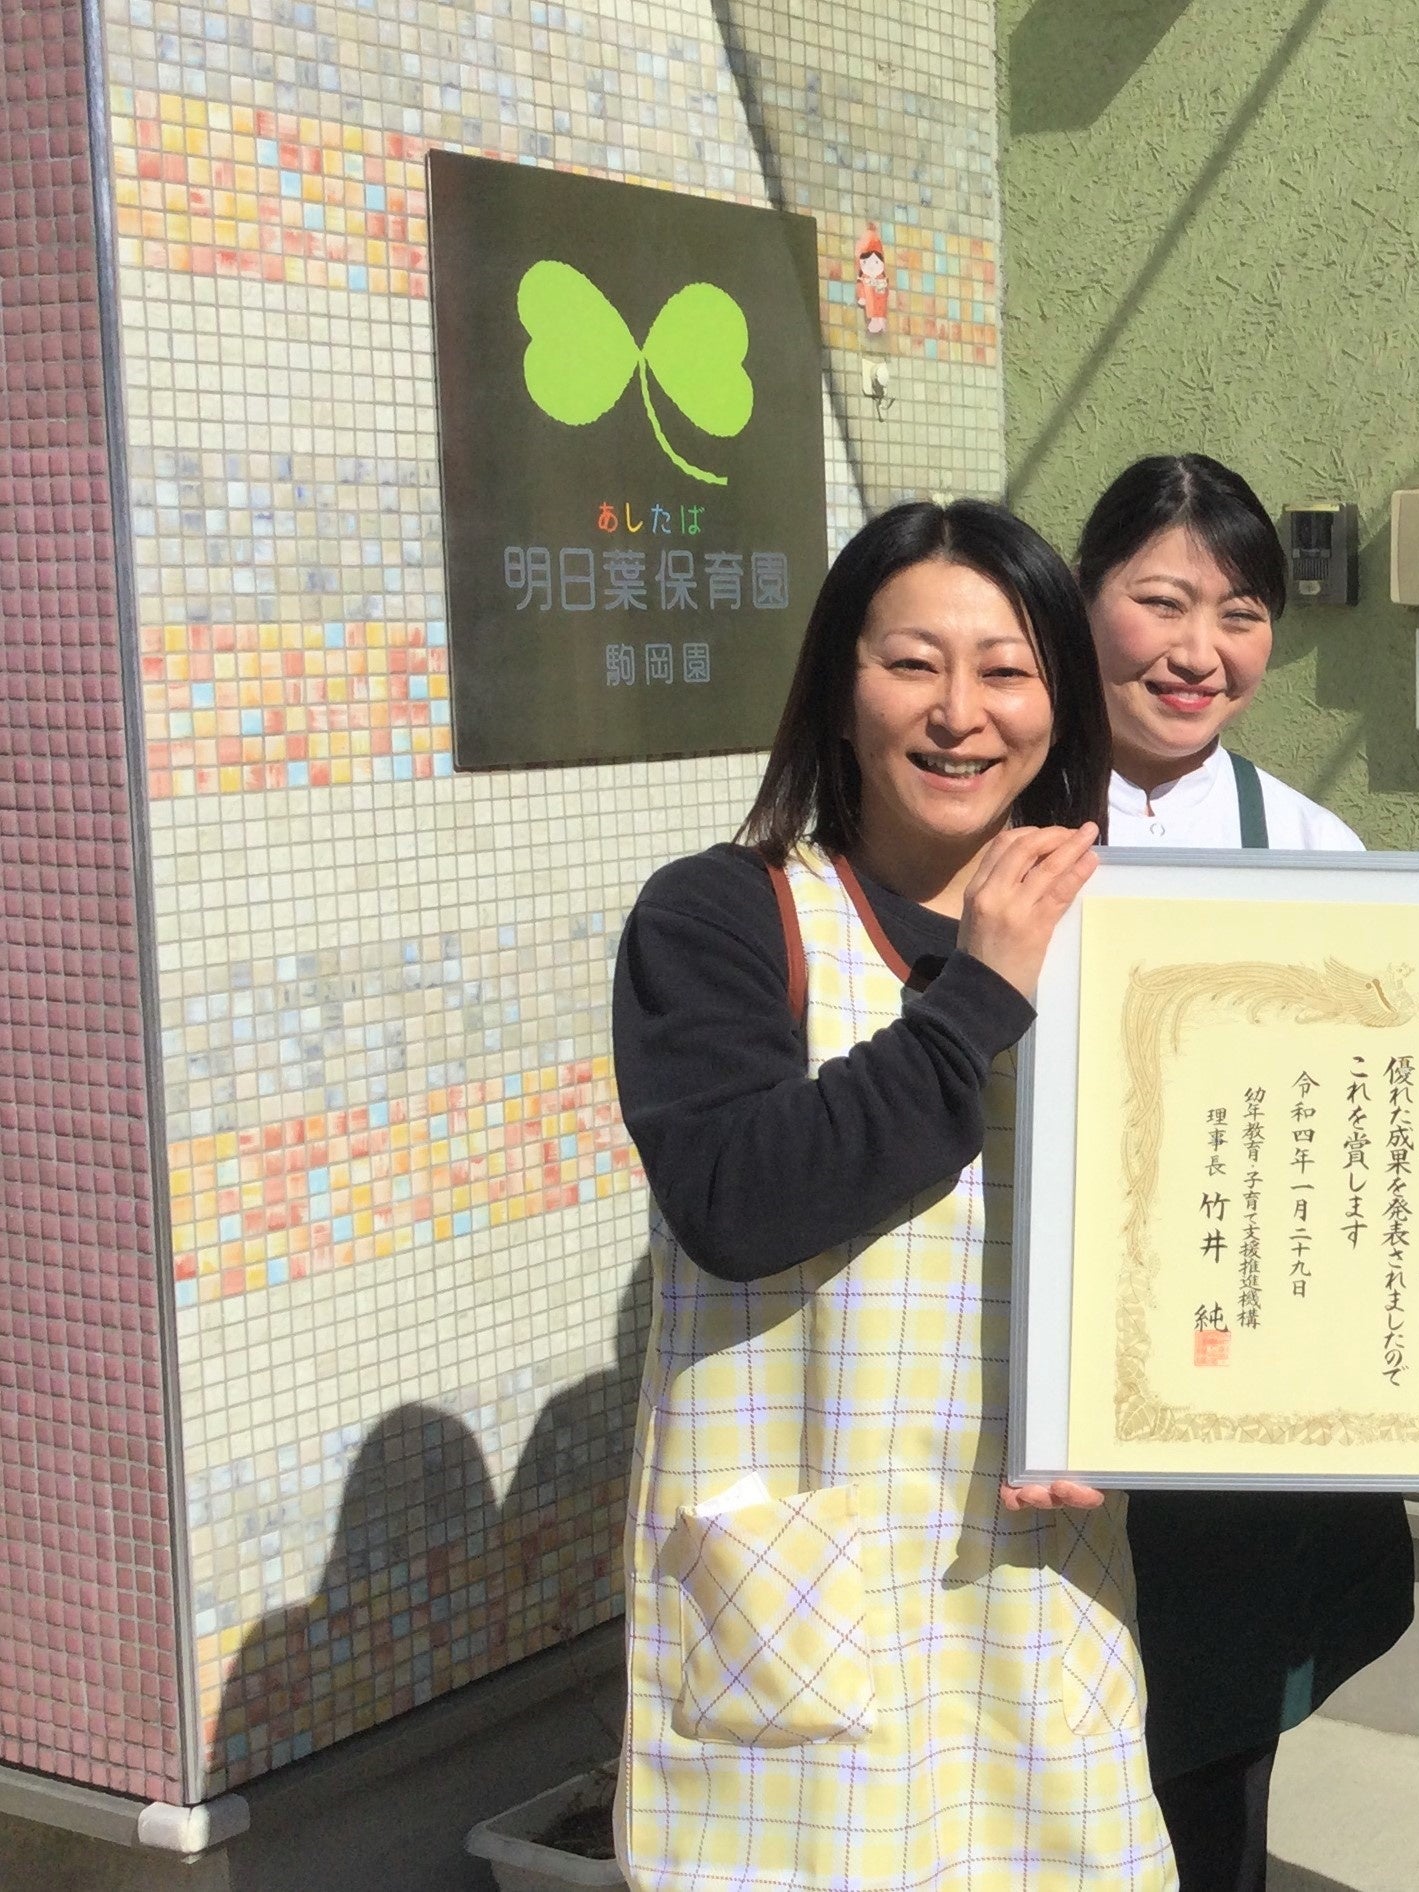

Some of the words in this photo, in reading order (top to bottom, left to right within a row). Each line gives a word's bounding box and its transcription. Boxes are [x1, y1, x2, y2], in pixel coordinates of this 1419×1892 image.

[598, 501, 706, 535] あしたば
[504, 545, 790, 612] 明日葉保育園
[605, 642, 712, 687] 駒岡園
[1204, 1107, 1229, 1177] 理事長
[1340, 1055, 1372, 1250] これを賞します
[1288, 1070, 1321, 1299] 令和四年一月二十九日
[1381, 1055, 1416, 1387] 優れた成果を発表されましたので
